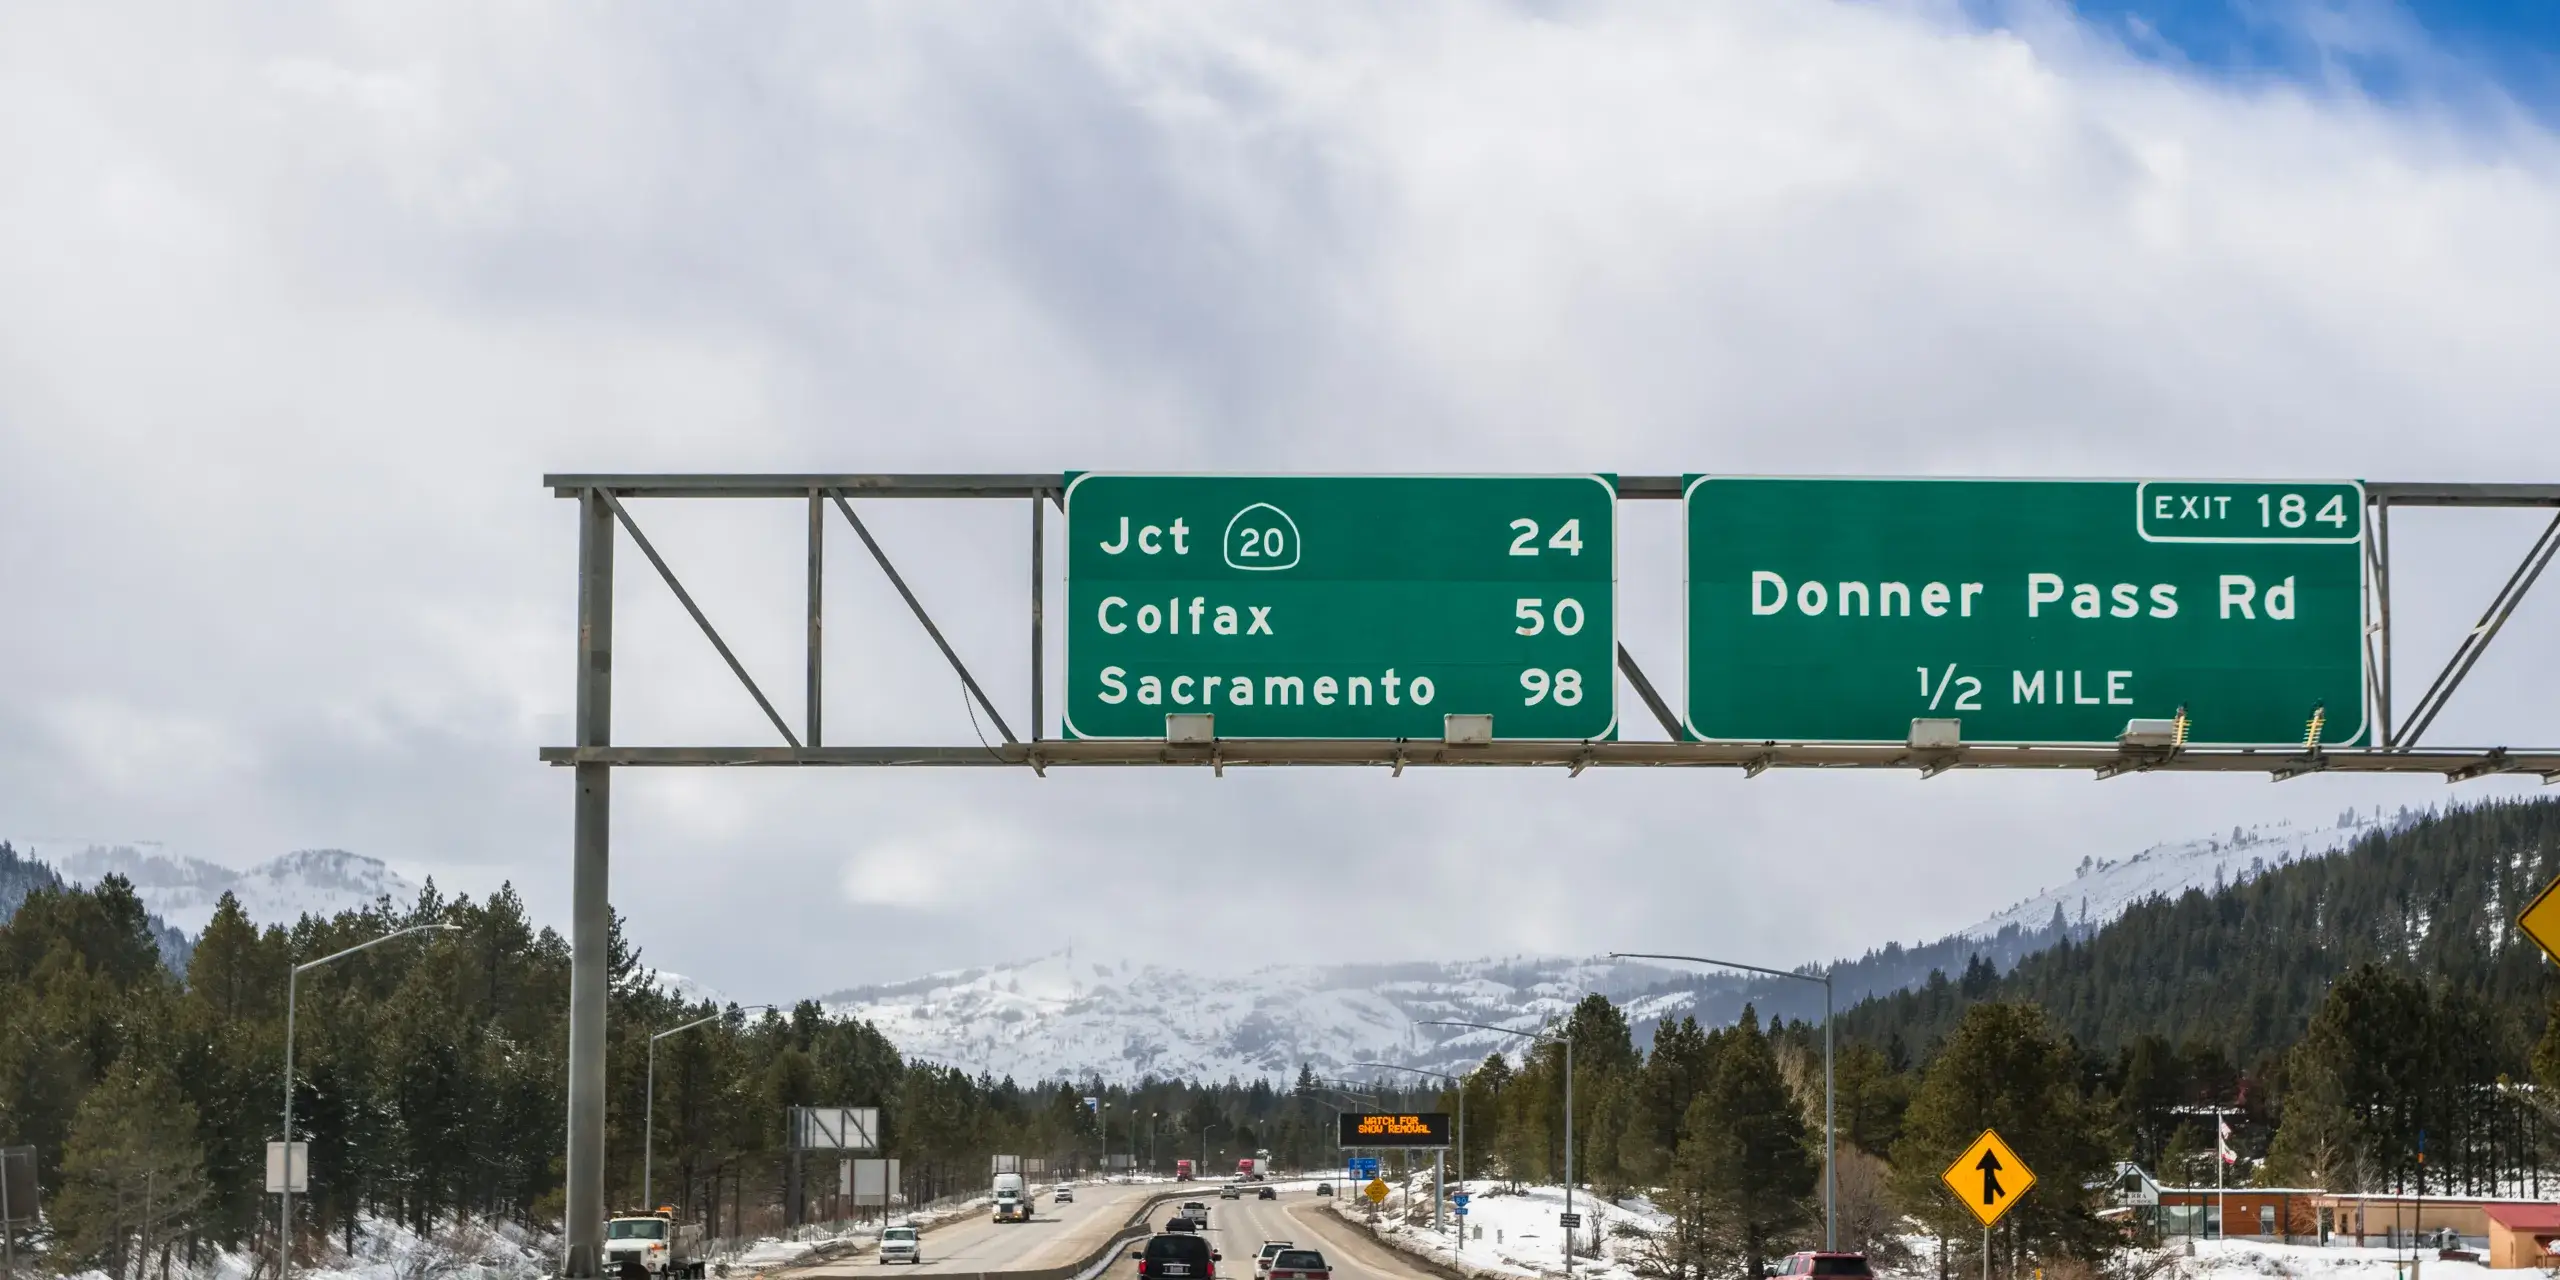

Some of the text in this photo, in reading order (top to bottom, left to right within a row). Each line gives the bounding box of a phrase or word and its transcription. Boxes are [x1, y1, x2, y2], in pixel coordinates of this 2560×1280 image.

[2156, 493, 2347, 529] EXIT 184
[1099, 516, 1583, 557] Jct 20 24
[1752, 571, 2297, 621] Donner Pass Rd
[1098, 597, 1585, 637] Colfax 50
[1098, 666, 1583, 707] Sacramento 98
[2014, 670, 2135, 706] MILE
[1358, 1124, 1431, 1134] SNOW REMOVAL
[1363, 1116, 1419, 1126] WATCH FOR
